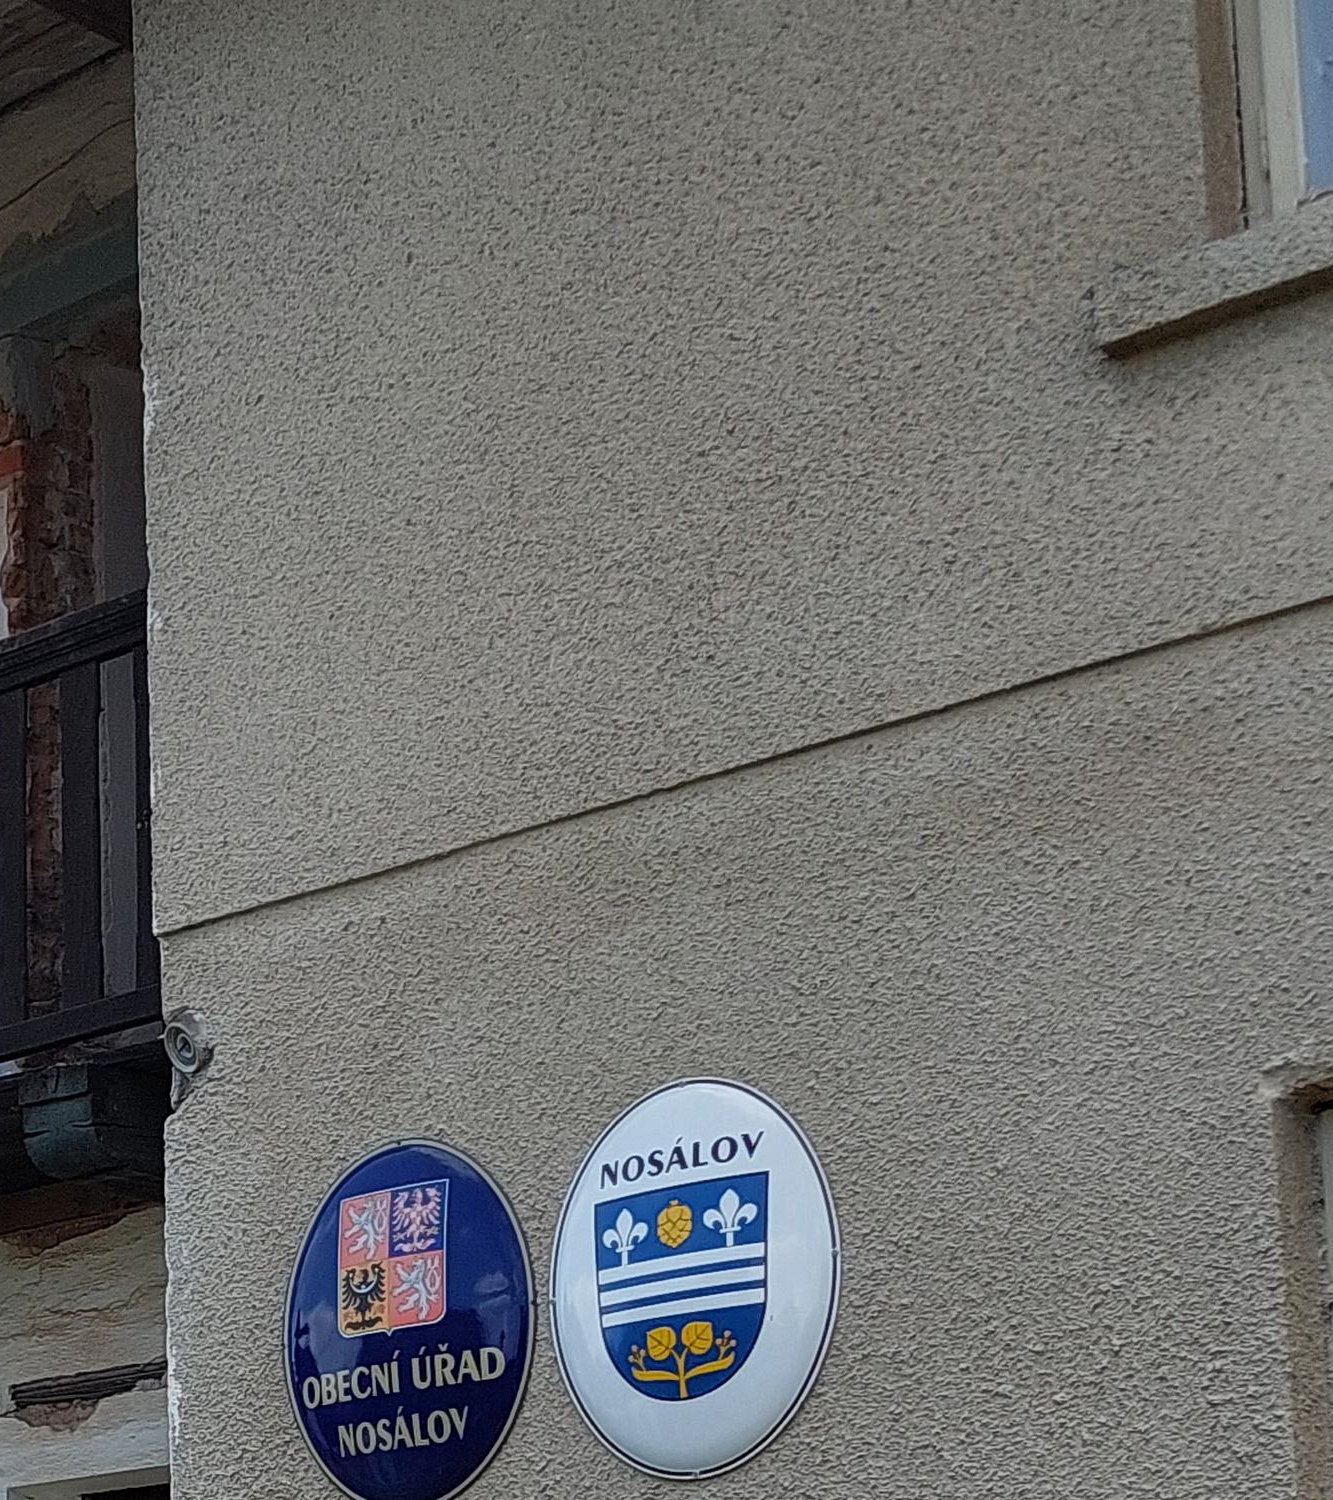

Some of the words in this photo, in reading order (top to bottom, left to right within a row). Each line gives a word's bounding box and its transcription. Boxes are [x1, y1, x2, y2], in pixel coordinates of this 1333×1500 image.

[599, 1131, 765, 1190] NOSÁLOV
[302, 1350, 400, 1409] OBECNÍ
[412, 1344, 506, 1386] ÚŘAD
[338, 1407, 469, 1458] NOSÁLOV
